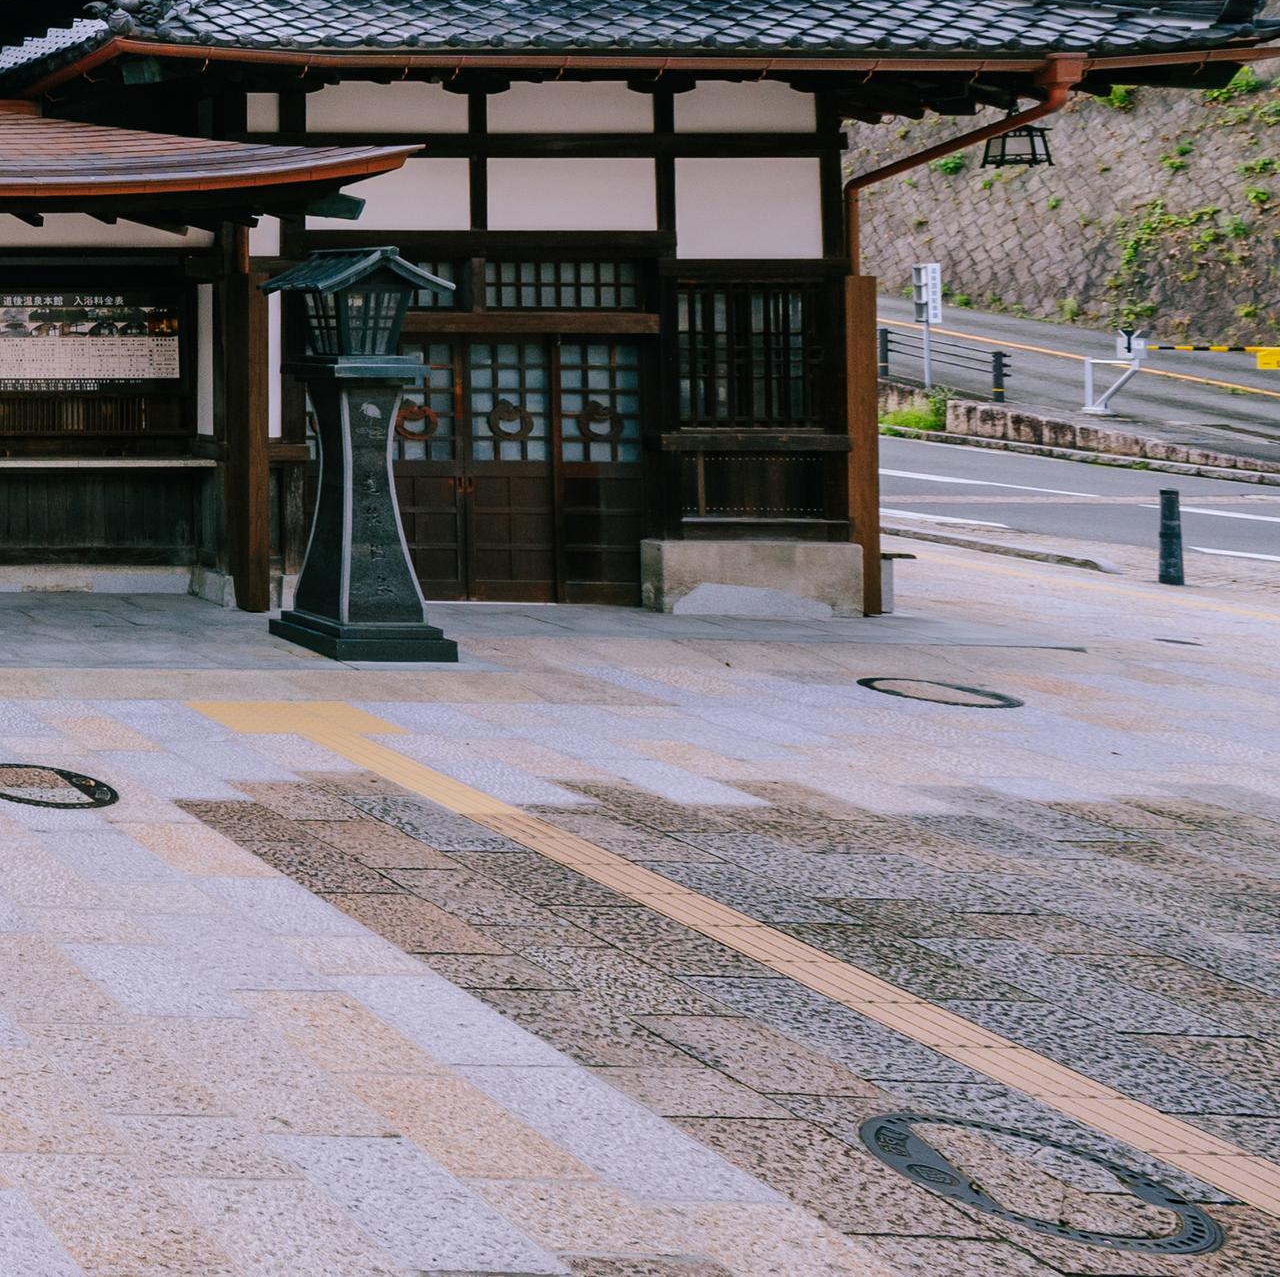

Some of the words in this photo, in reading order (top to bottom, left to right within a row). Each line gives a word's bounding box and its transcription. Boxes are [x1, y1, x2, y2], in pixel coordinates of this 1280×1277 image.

[2, 295, 64, 307] 道後温泉本館
[73, 295, 125, 307] 入浴料金表
